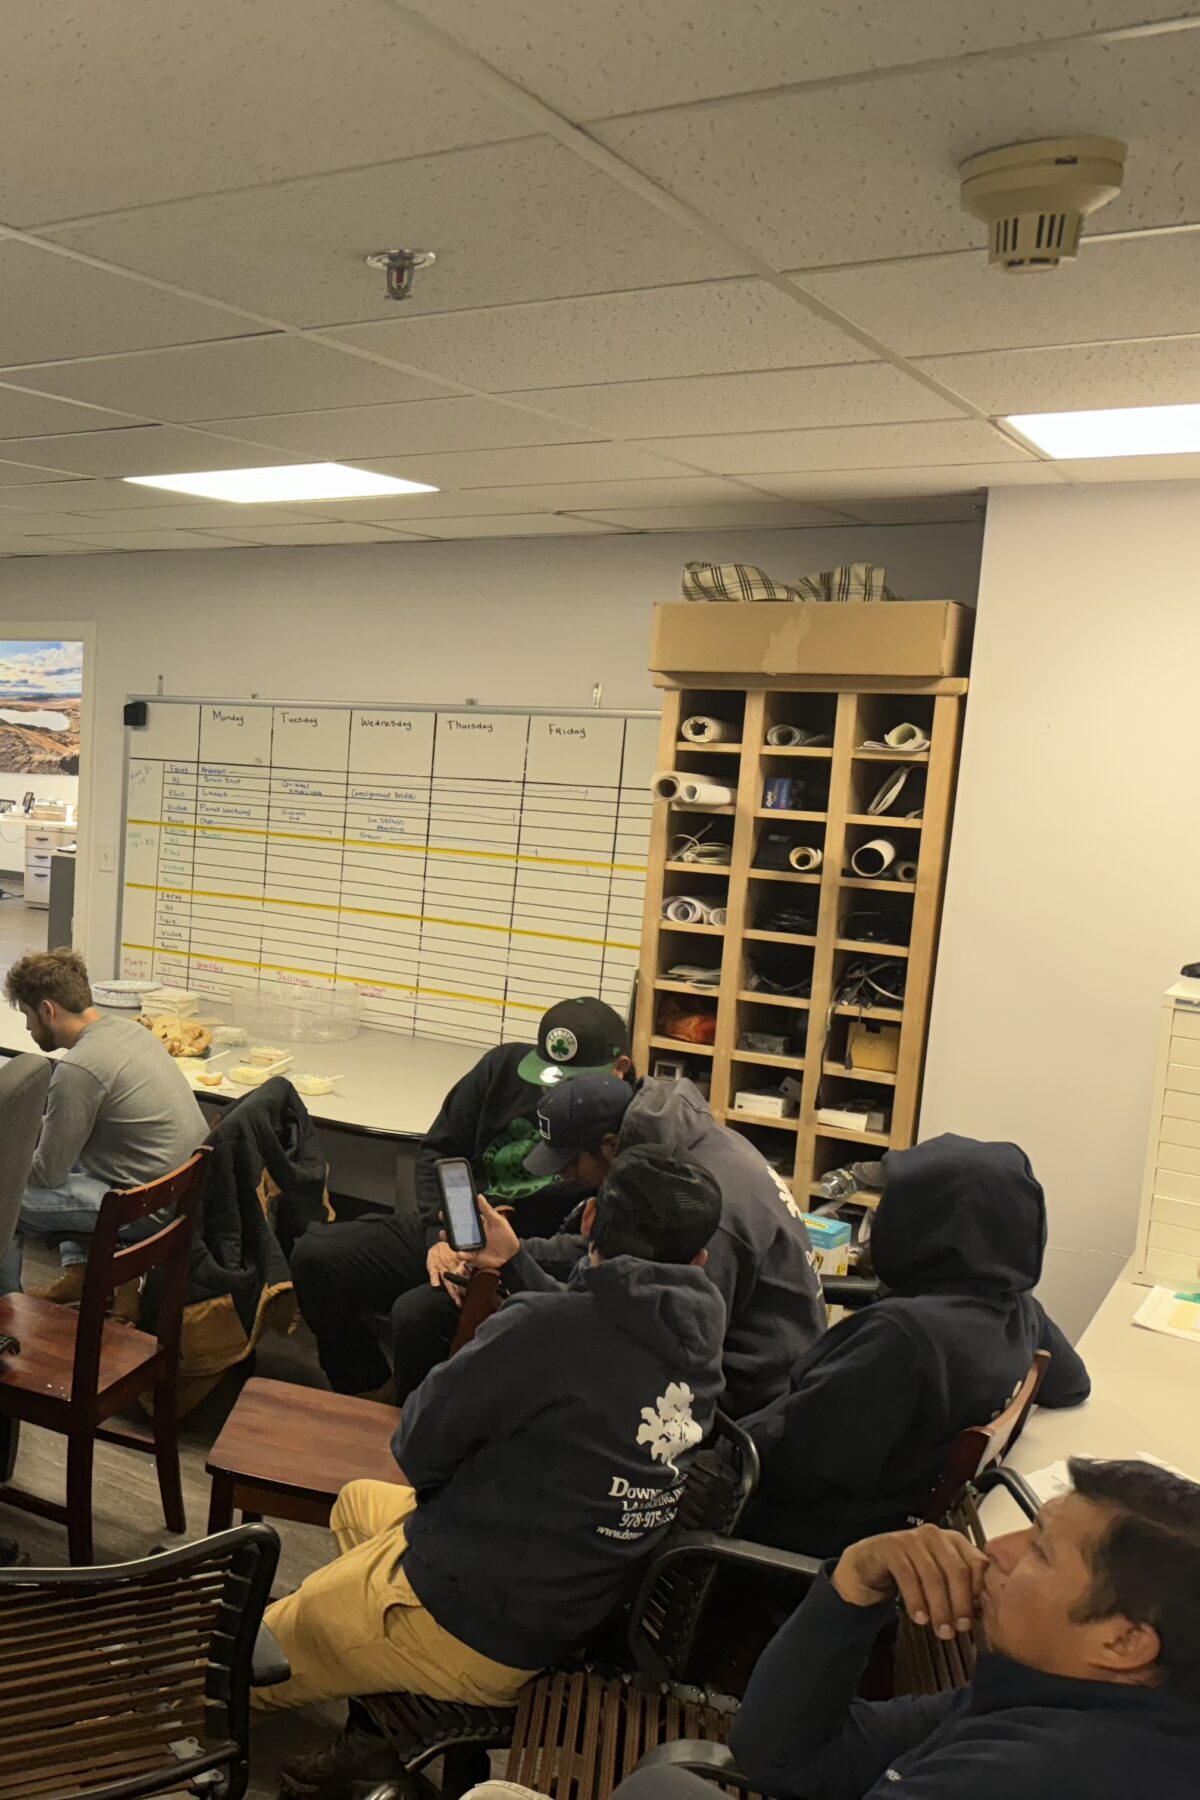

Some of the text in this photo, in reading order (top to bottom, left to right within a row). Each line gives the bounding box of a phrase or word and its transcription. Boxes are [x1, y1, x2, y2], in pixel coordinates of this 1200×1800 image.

[212, 710, 244, 726] Monday
[280, 712, 318, 727] Tuesday
[361, 717, 412, 730] Wednesday
[446, 720, 494, 733] Thursday
